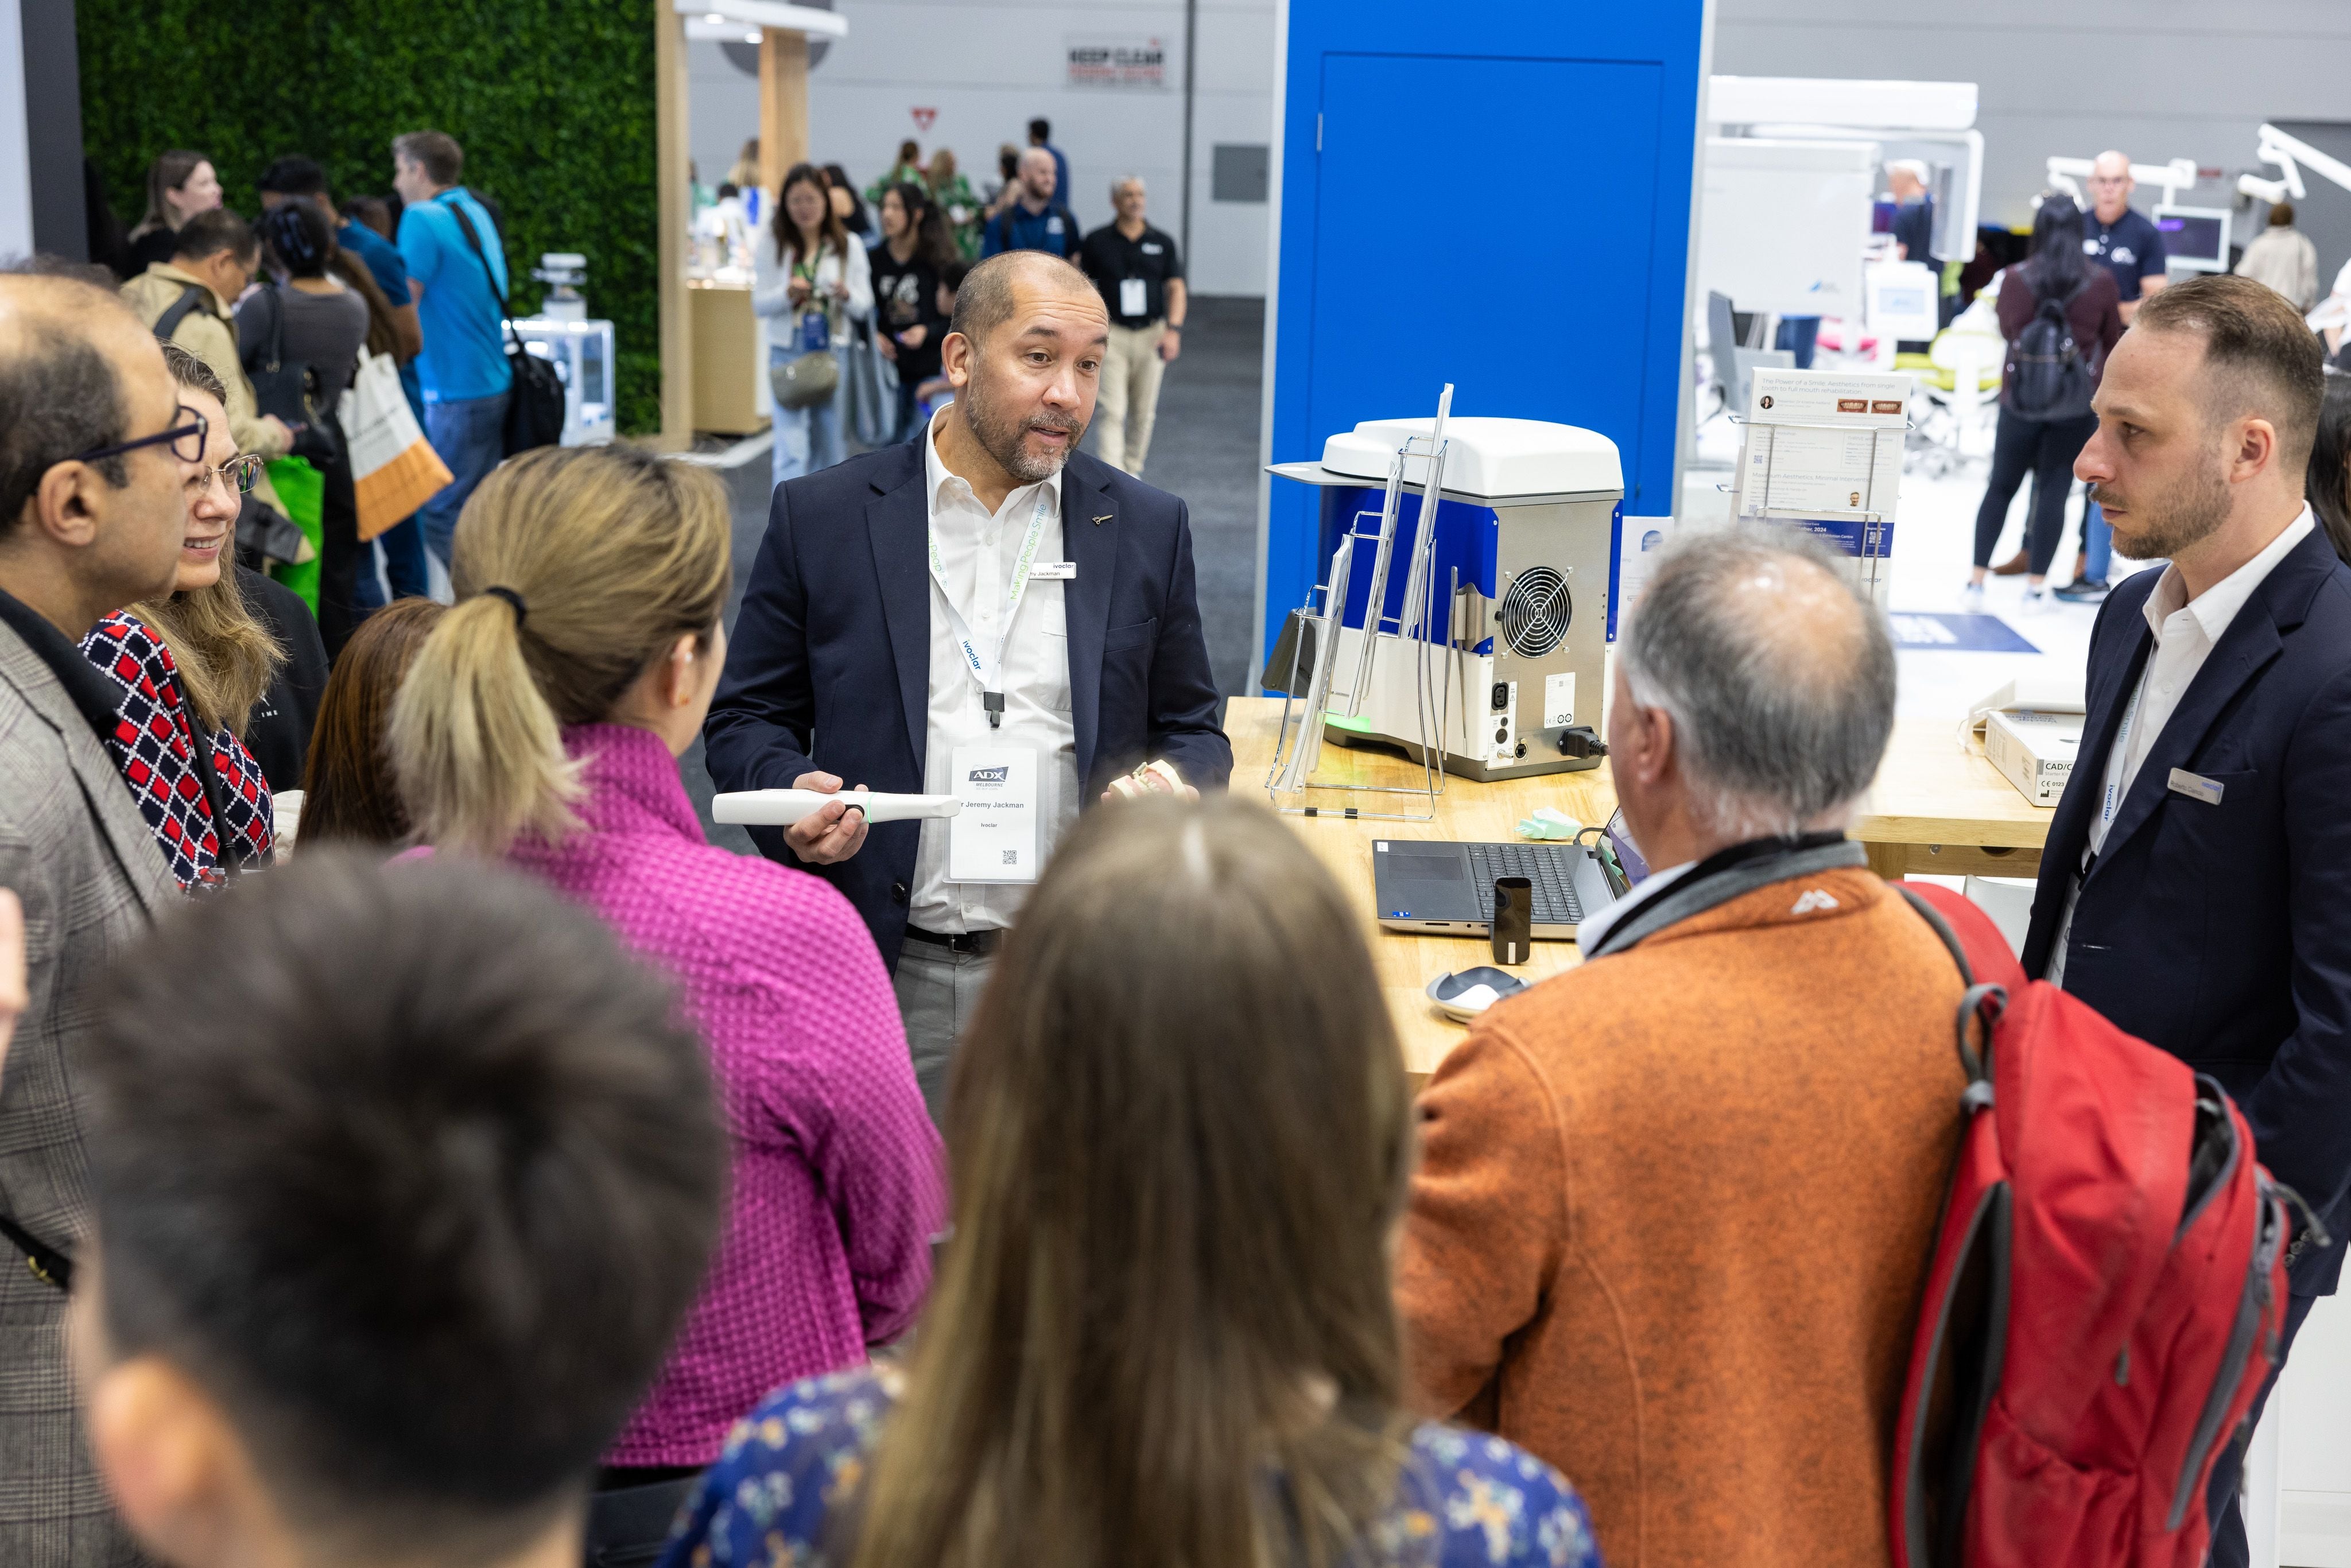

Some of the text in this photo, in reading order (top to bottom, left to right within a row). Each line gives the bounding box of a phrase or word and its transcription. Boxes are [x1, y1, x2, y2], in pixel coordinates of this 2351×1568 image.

[1010, 503, 1046, 600] Making People Smile
[963, 639, 981, 670] ivoclar
[2119, 710, 2135, 743] Smile
[973, 771, 1005, 781] ADX
[2046, 763, 2073, 771] CAD/C
[2104, 785, 2116, 821] ivoclar
